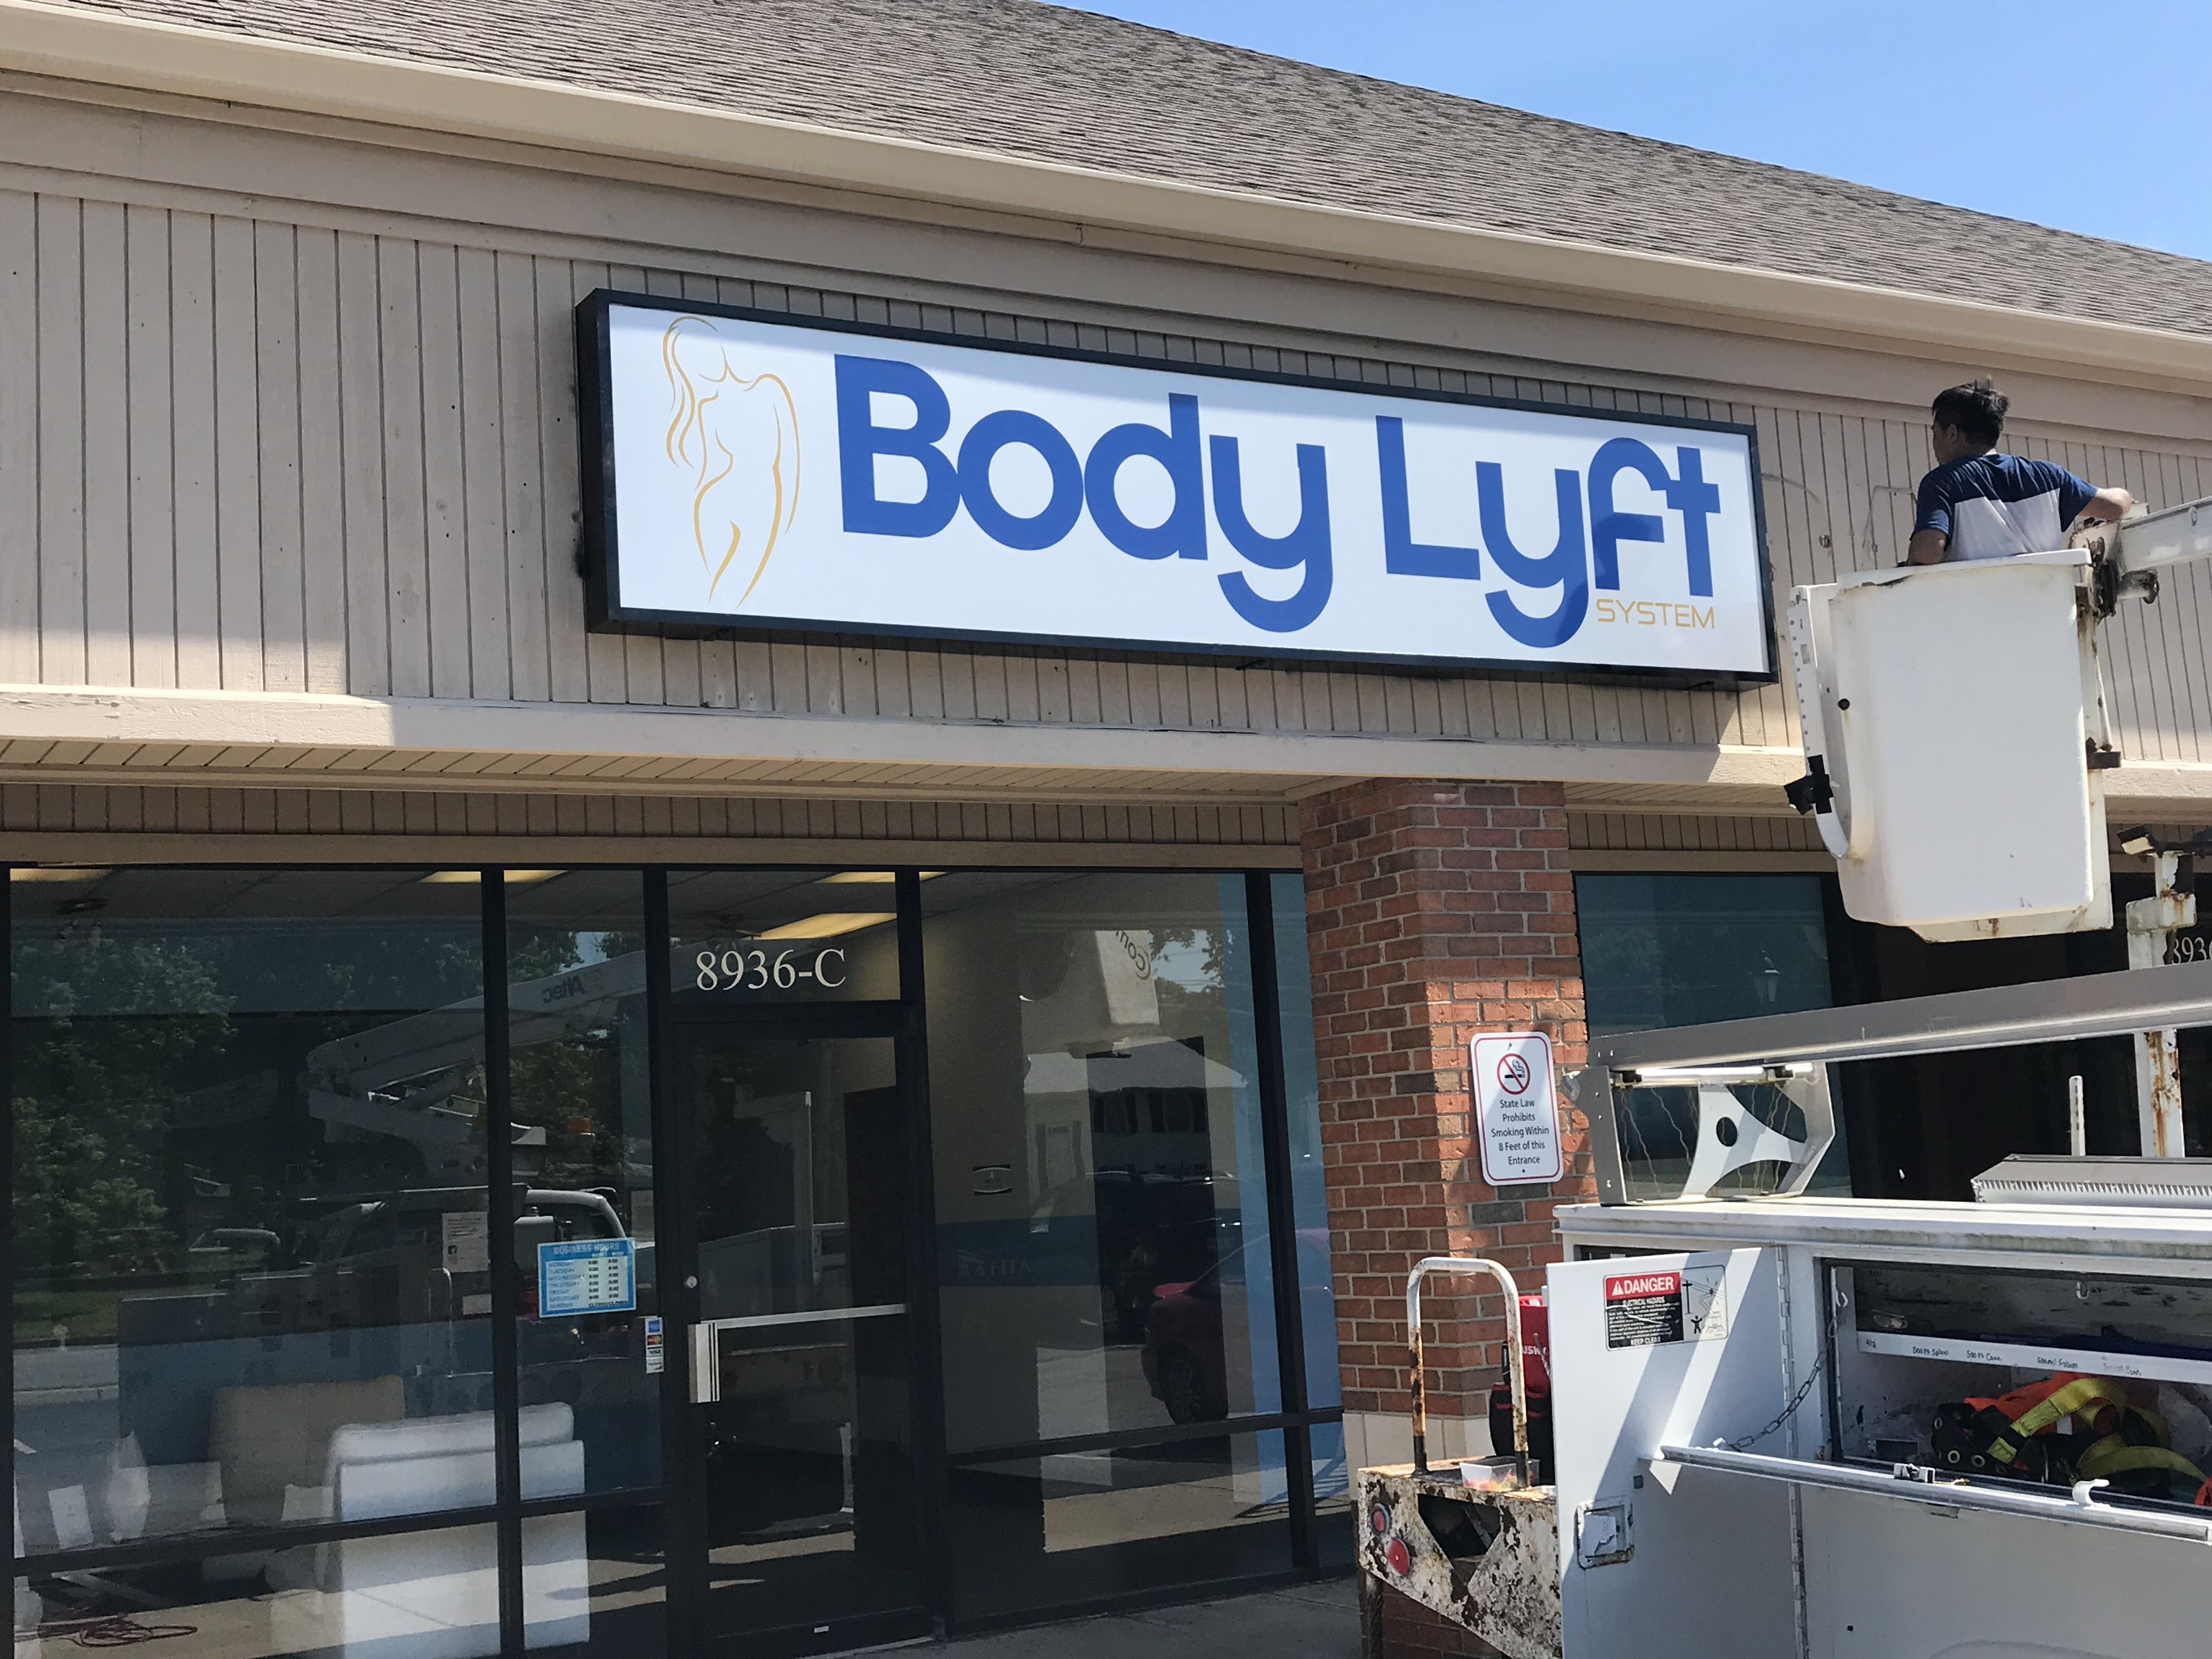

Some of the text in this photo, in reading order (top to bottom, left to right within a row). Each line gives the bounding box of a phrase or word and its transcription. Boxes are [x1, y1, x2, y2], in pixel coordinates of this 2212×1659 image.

[835, 354, 1722, 648] Body Lyft
[1596, 598, 1714, 629] SYSTEM
[2171, 936, 2212, 964] 893
[696, 949, 846, 991] 8936-C
[1499, 1098, 1535, 1109] State Law
[1502, 1113, 1536, 1122] Prohibits
[1491, 1126, 1549, 1138] Smoking Within
[1498, 1141, 1545, 1152] 8 Feet of this
[1508, 1155, 1541, 1165] Entrance
[554, 1244, 591, 1255] BUSINESS
[594, 1242, 620, 1251] HOURS
[1624, 1277, 1674, 1294] DANGER
